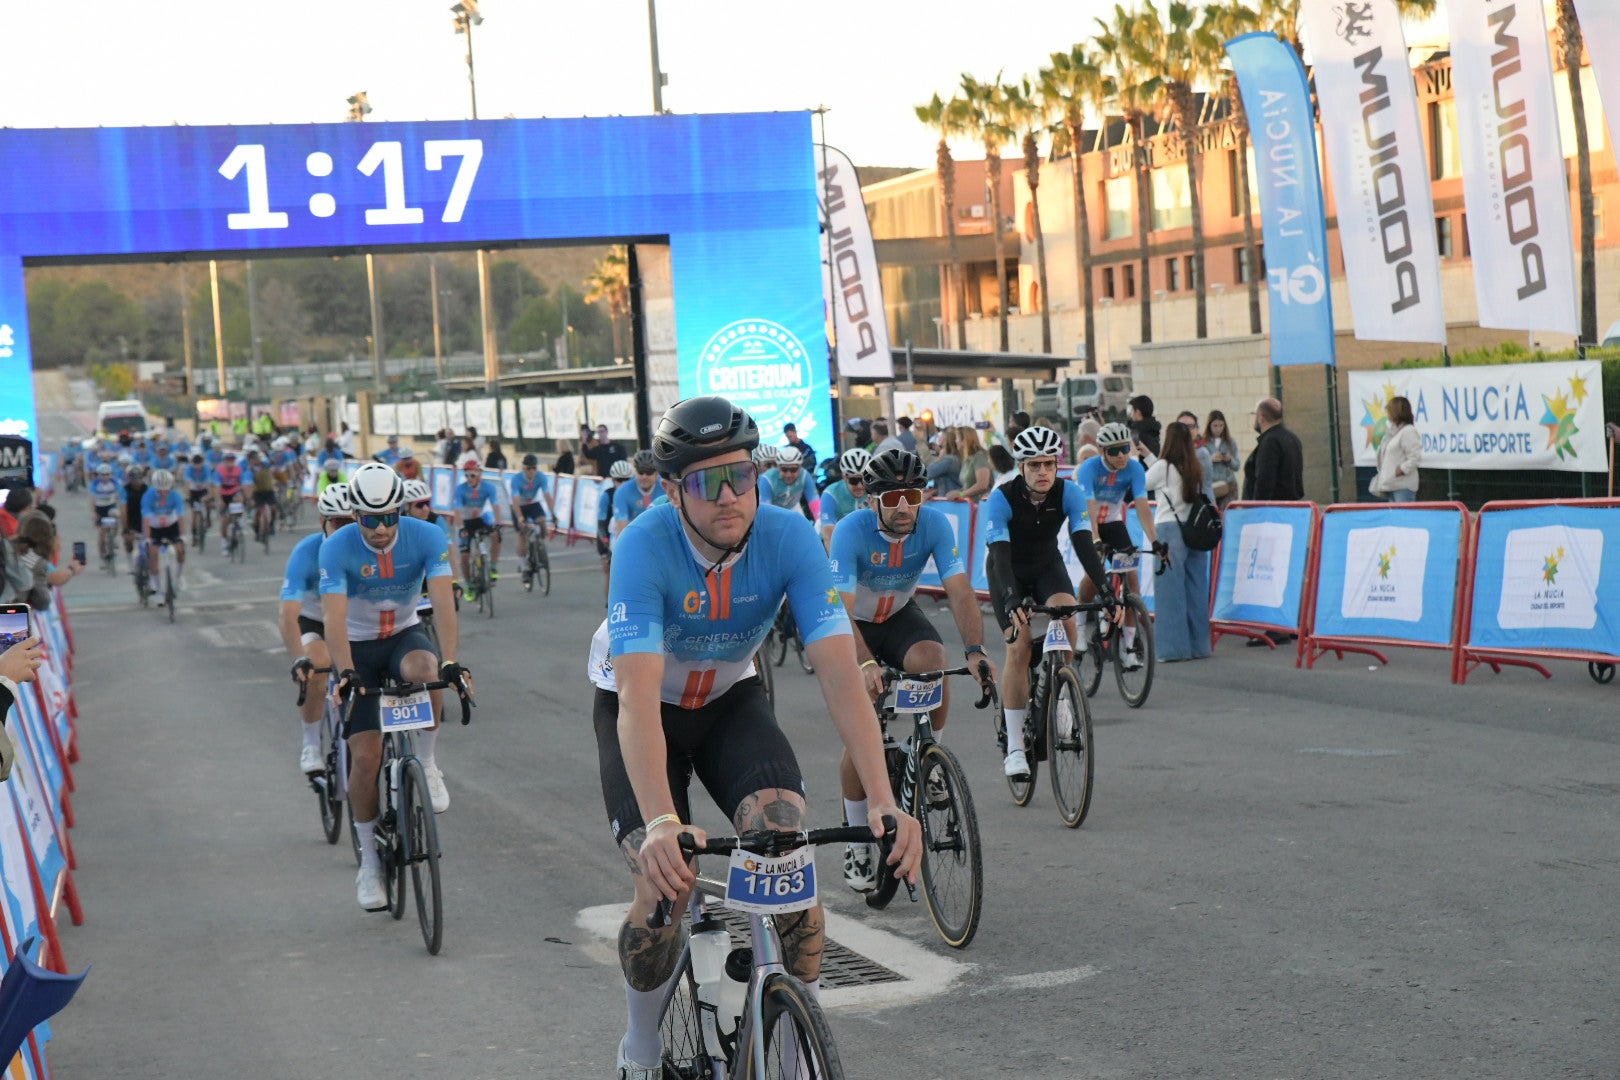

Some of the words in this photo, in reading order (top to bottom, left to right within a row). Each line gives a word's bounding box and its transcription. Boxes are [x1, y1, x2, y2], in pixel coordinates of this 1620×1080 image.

[218, 139, 484, 230] 1:17
[709, 363, 803, 391] CRITERIUM
[1449, 433, 1472, 454] DEL
[1474, 432, 1533, 455] DEPORTE
[908, 689, 935, 704] 577
[392, 705, 419, 721] 901
[765, 863, 776, 875] LA
[744, 870, 806, 897] 1163
